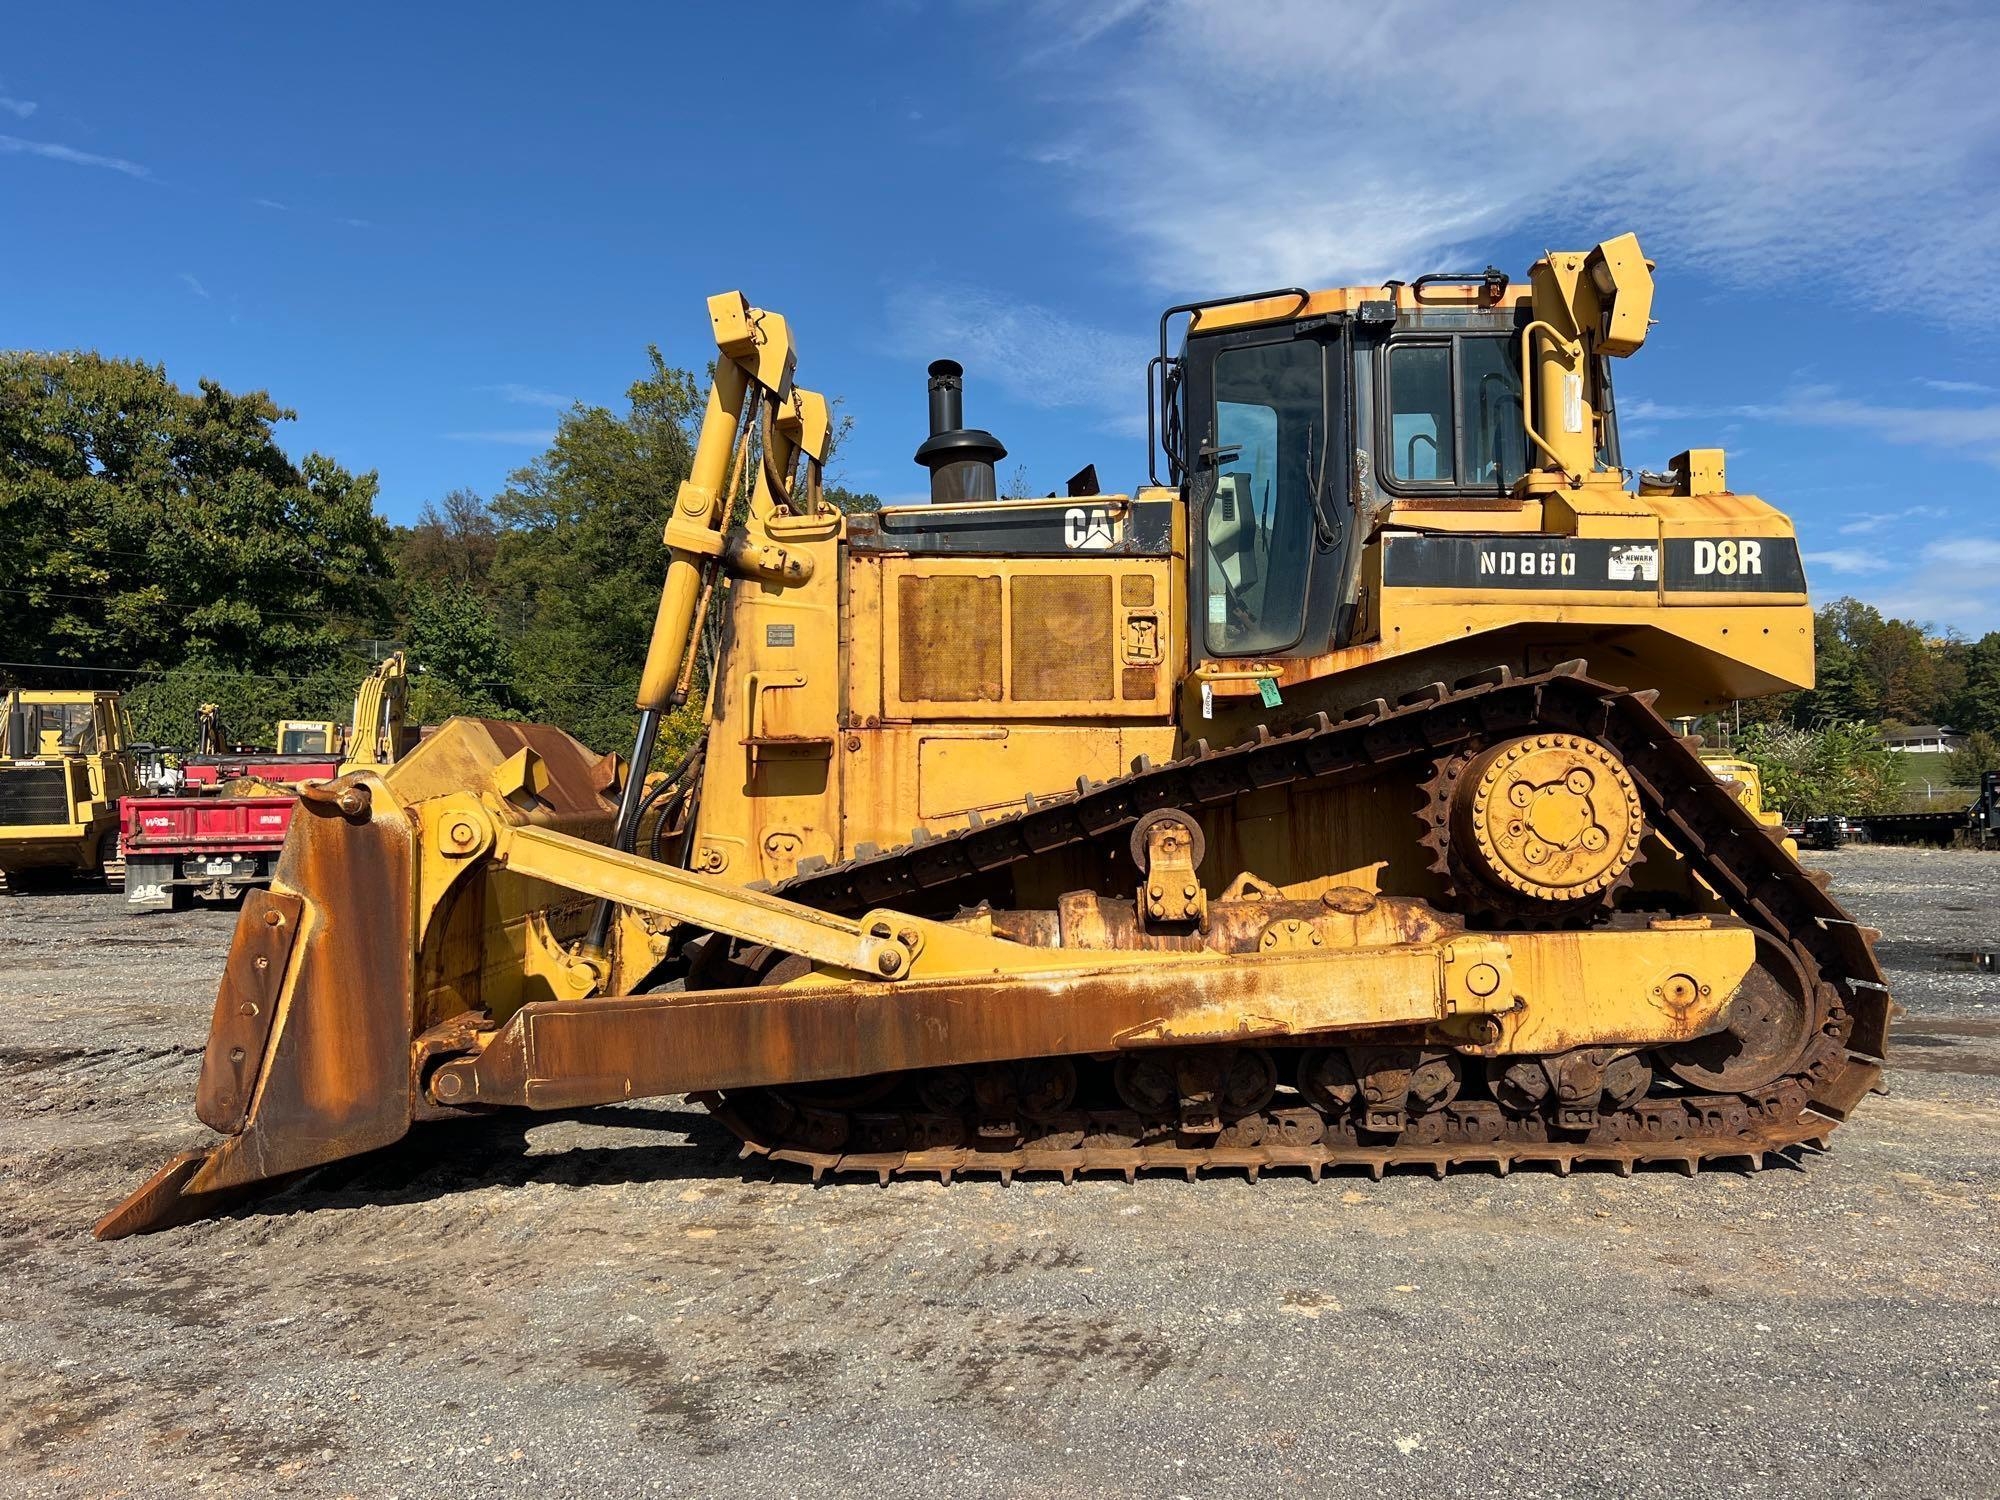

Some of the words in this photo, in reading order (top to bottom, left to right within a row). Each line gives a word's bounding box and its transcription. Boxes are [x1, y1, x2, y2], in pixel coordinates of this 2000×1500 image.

[1065, 509, 1129, 549] CAT
[1481, 551, 1576, 576] ND860
[1625, 554, 1653, 562] NEWARK
[1694, 540, 1762, 575] D8R
[130, 884, 167, 899] ABC
